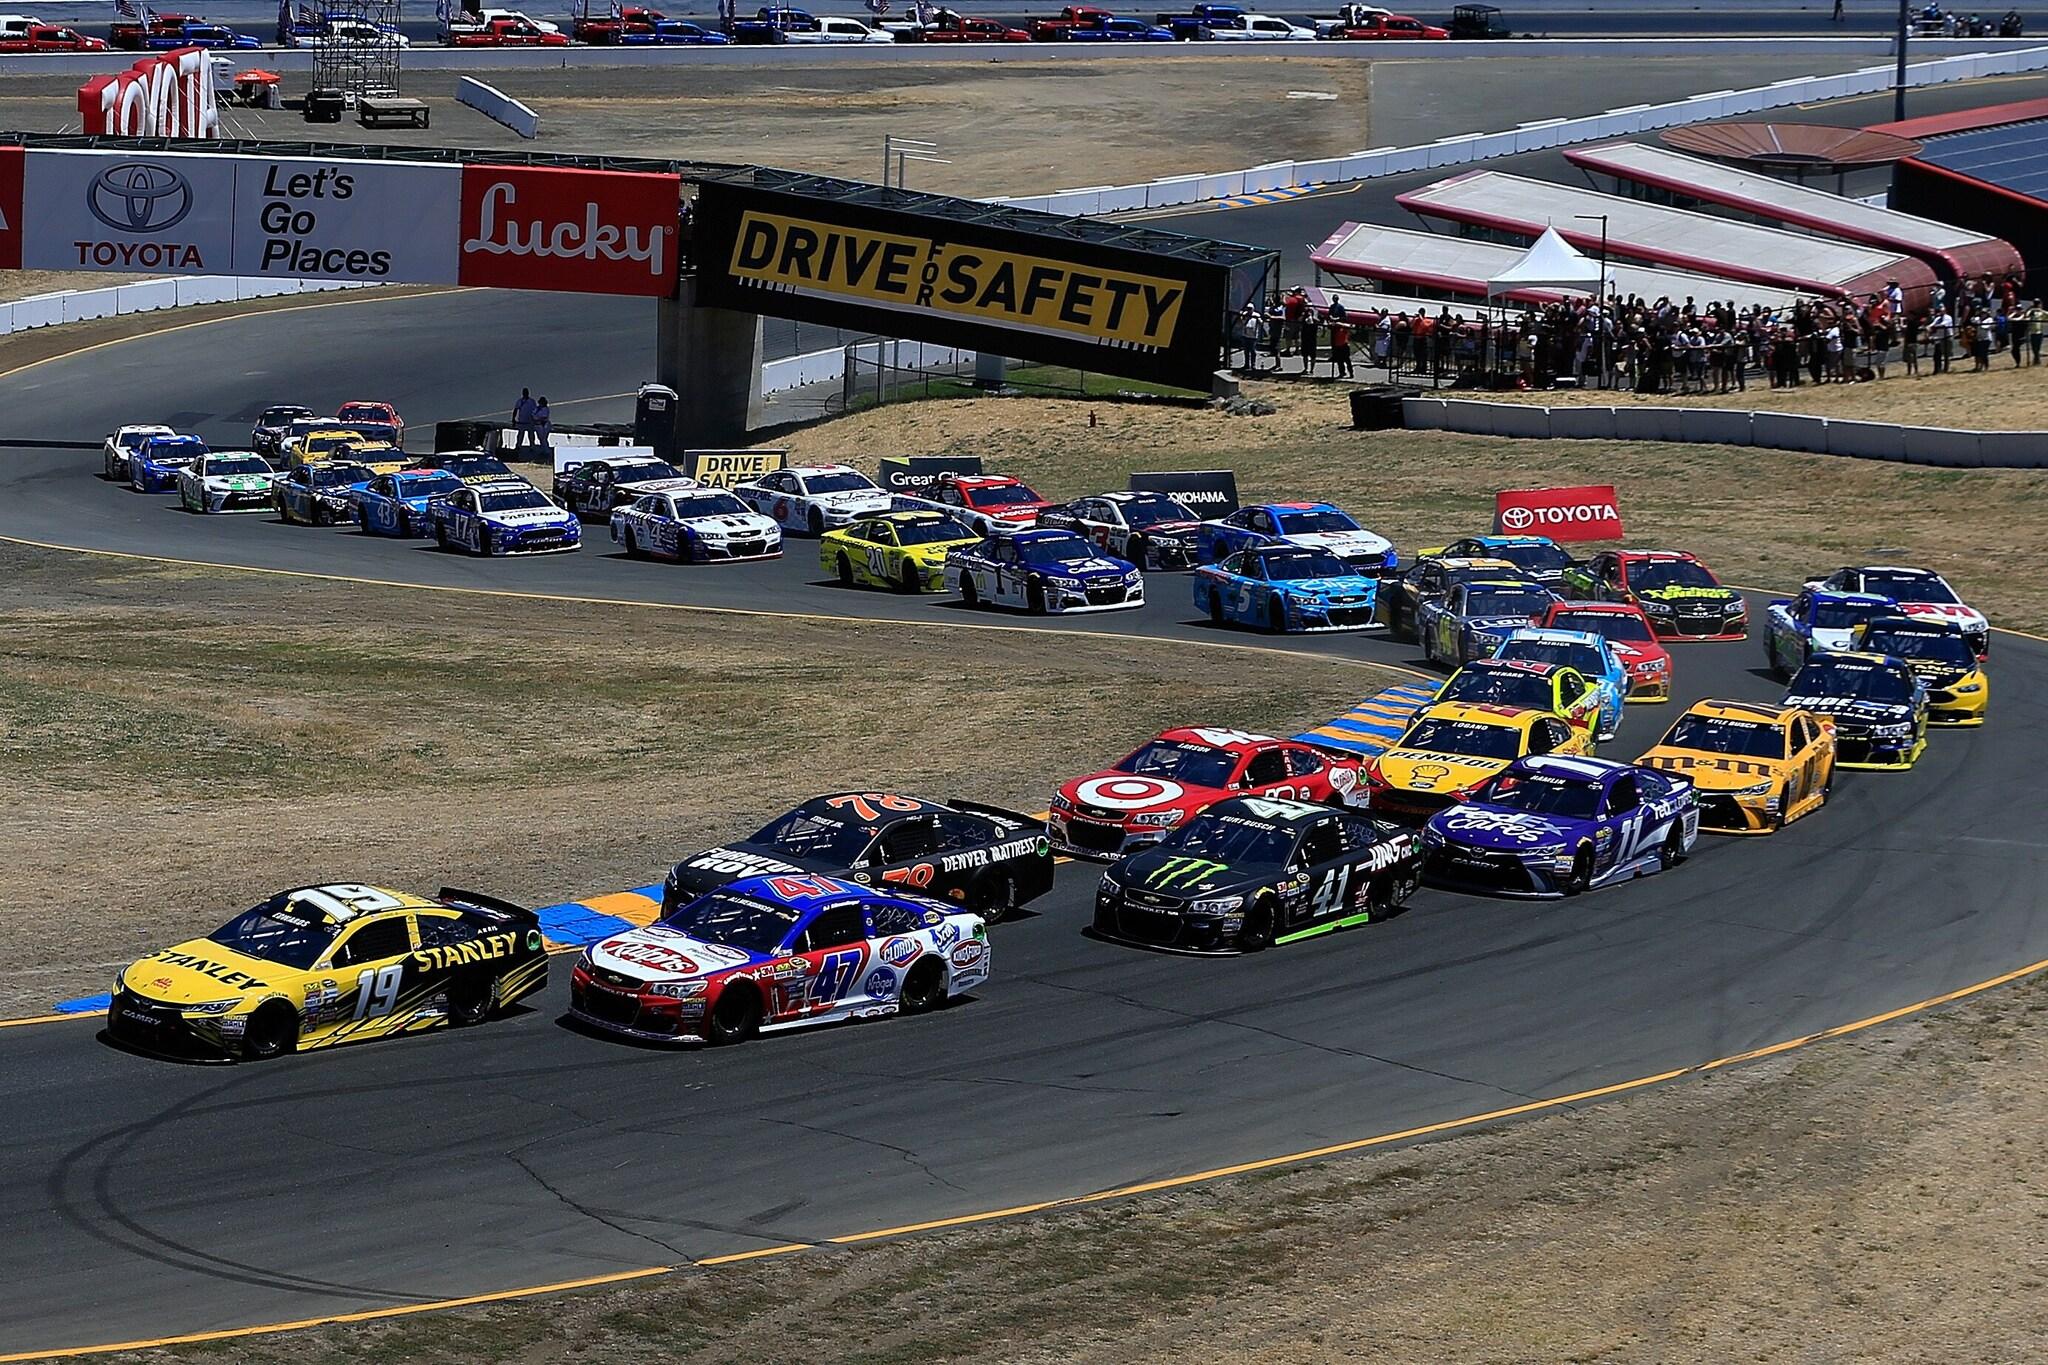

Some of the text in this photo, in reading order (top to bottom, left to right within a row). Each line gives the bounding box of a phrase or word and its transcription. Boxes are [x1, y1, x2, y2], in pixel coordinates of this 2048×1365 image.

[263, 164, 354, 199] Let's
[260, 201, 315, 235] Go
[464, 182, 663, 275] Lucky
[74, 241, 203, 268] TOYOTA
[260, 238, 392, 277] Places
[737, 221, 918, 294] DRIVE
[915, 243, 943, 307] FOR
[940, 254, 1182, 337] SAFETY
[707, 457, 763, 472] DRIVE
[890, 472, 935, 486] Great
[377, 502, 391, 526] 43
[455, 514, 468, 539] 17
[1534, 505, 1618, 523] TOYOTA
[1089, 525, 1109, 553] 3
[865, 546, 887, 577] 20
[1238, 581, 1253, 612] 5
[1784, 696, 1854, 707] CODE
[1451, 722, 1489, 731] LOGANO
[1729, 720, 1758, 729] BUSCH
[1177, 742, 1211, 754] LARSON
[1388, 750, 1504, 770] PENNZOIL
[1530, 774, 1567, 785] HAMLIN
[826, 791, 922, 822] 78
[1220, 815, 1276, 831] KURT BUSCH
[1444, 804, 1573, 837] FedEx
[1447, 818, 1540, 842] cares
[1616, 816, 1643, 864] 11
[941, 850, 990, 873] DENVER
[989, 837, 1036, 863] MATTRESS
[769, 874, 846, 899] 47
[1312, 864, 1350, 917] 41
[271, 912, 310, 928] EDWARDS
[477, 925, 498, 935] ARRIS
[413, 931, 517, 973] STANLEY
[883, 937, 918, 963] CLOROX
[144, 950, 268, 990] STANLEY
[810, 948, 864, 1006] 47
[353, 965, 404, 1021] 19
[868, 973, 894, 996] Kroger
[121, 1009, 162, 1025] CAMRY
